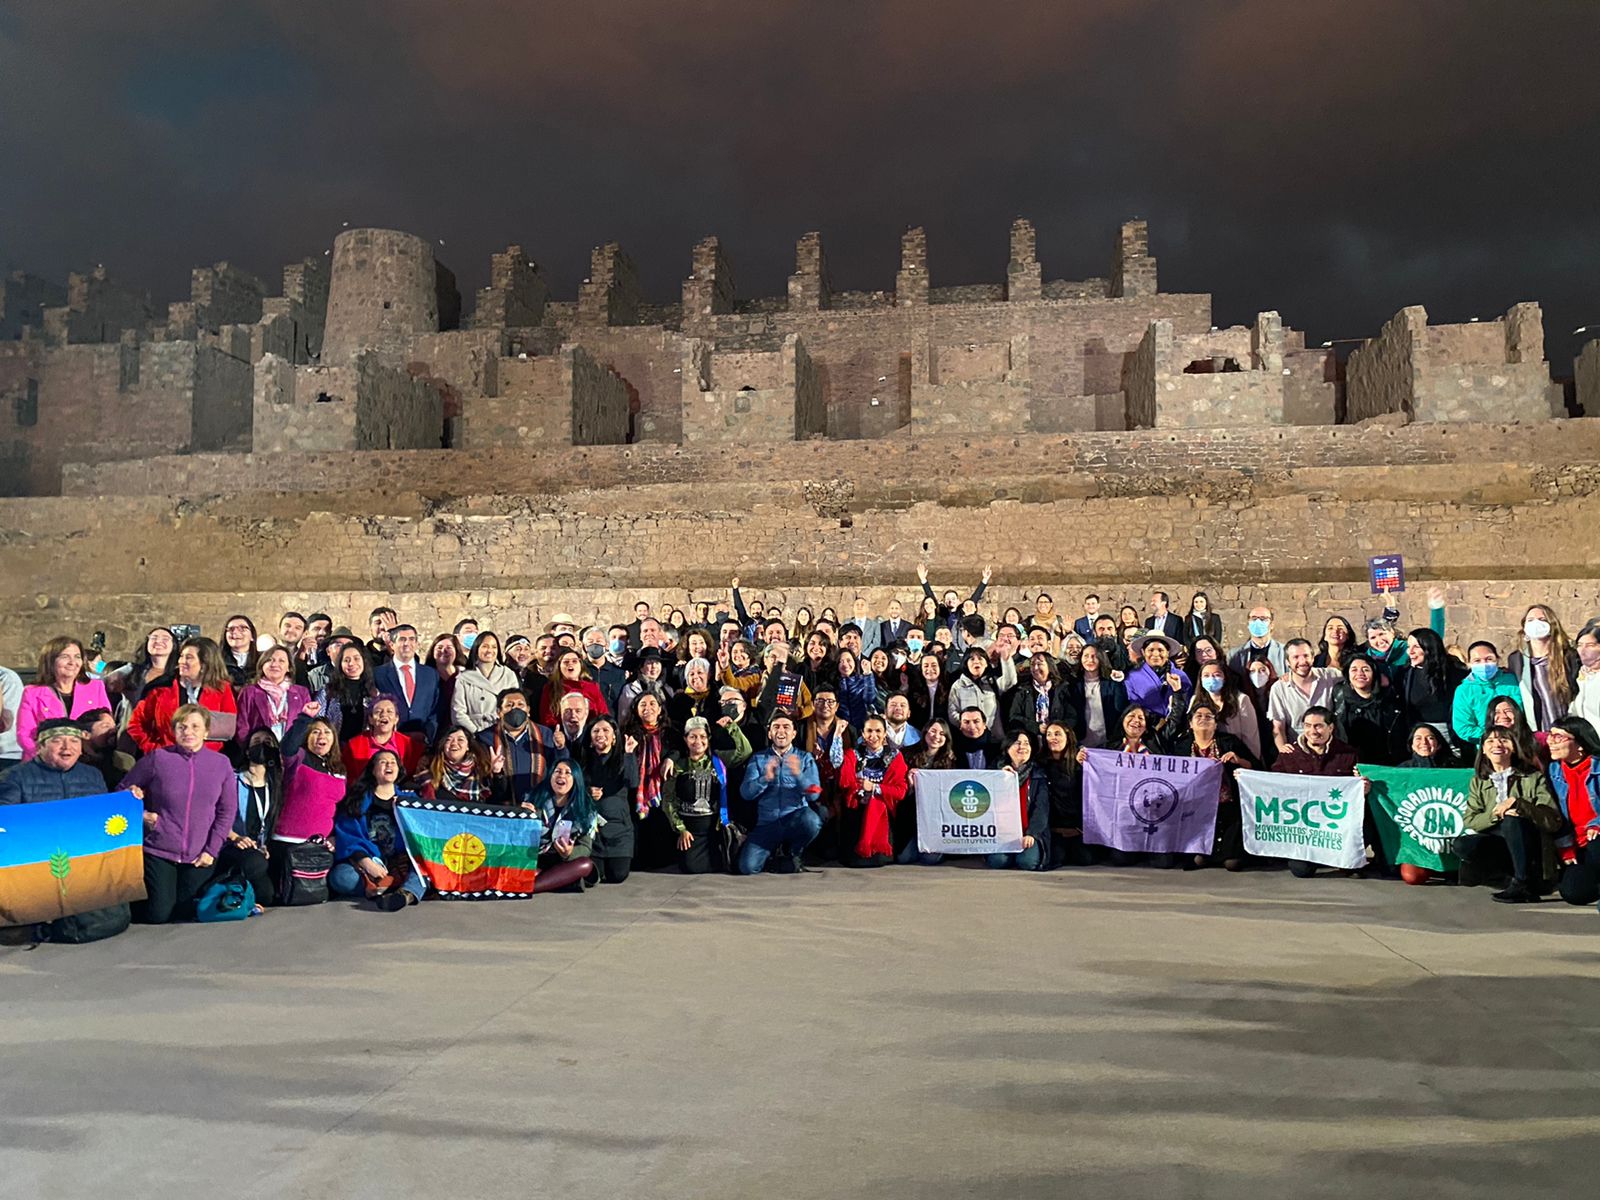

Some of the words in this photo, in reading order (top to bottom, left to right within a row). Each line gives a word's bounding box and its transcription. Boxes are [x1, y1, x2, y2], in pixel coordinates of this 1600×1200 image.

[1115, 753, 1199, 774] ANAMURI
[941, 824, 997, 838] PUEBLO
[1423, 807, 1456, 835] 8M
[1254, 830, 1343, 851] CONSTITUYENTES
[1255, 823, 1307, 835] MOVIMIENTOS
[1309, 828, 1342, 841] SOCIALES
[1402, 824, 1456, 854] FEMINI
